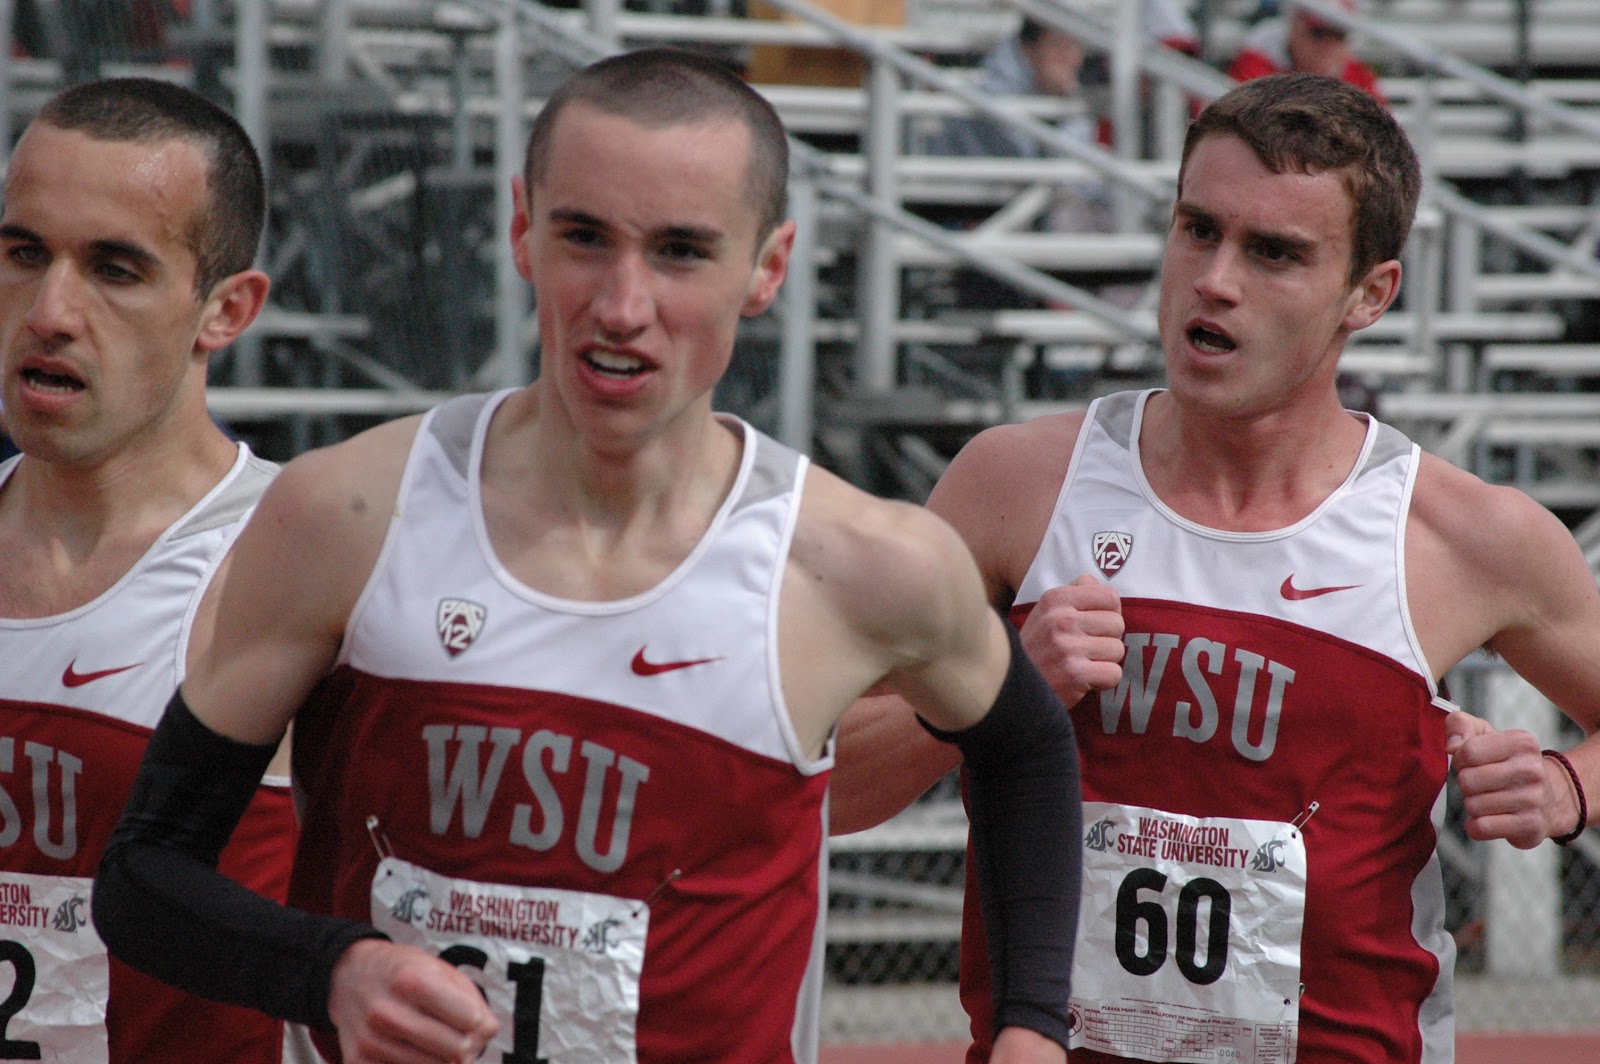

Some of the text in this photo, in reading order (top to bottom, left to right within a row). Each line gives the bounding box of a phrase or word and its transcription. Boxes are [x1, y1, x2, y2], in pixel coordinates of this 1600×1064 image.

[1094, 533, 1132, 560] PAC
[1100, 551, 1121, 569] 12
[440, 600, 486, 629] PAC
[444, 624, 470, 649] 12
[1100, 632, 1296, 761] WSU
[422, 725, 650, 873] WSU
[1139, 817, 1229, 847] WASHINGTON
[1117, 833, 1249, 868] STATE UNIVERSITY
[0, 883, 31, 905] TON
[451, 890, 559, 921] WASHINGTON
[427, 908, 579, 950] STATE UNIVERSITY
[1115, 868, 1231, 985] 60
[1219, 1048, 1240, 1059] 0060
